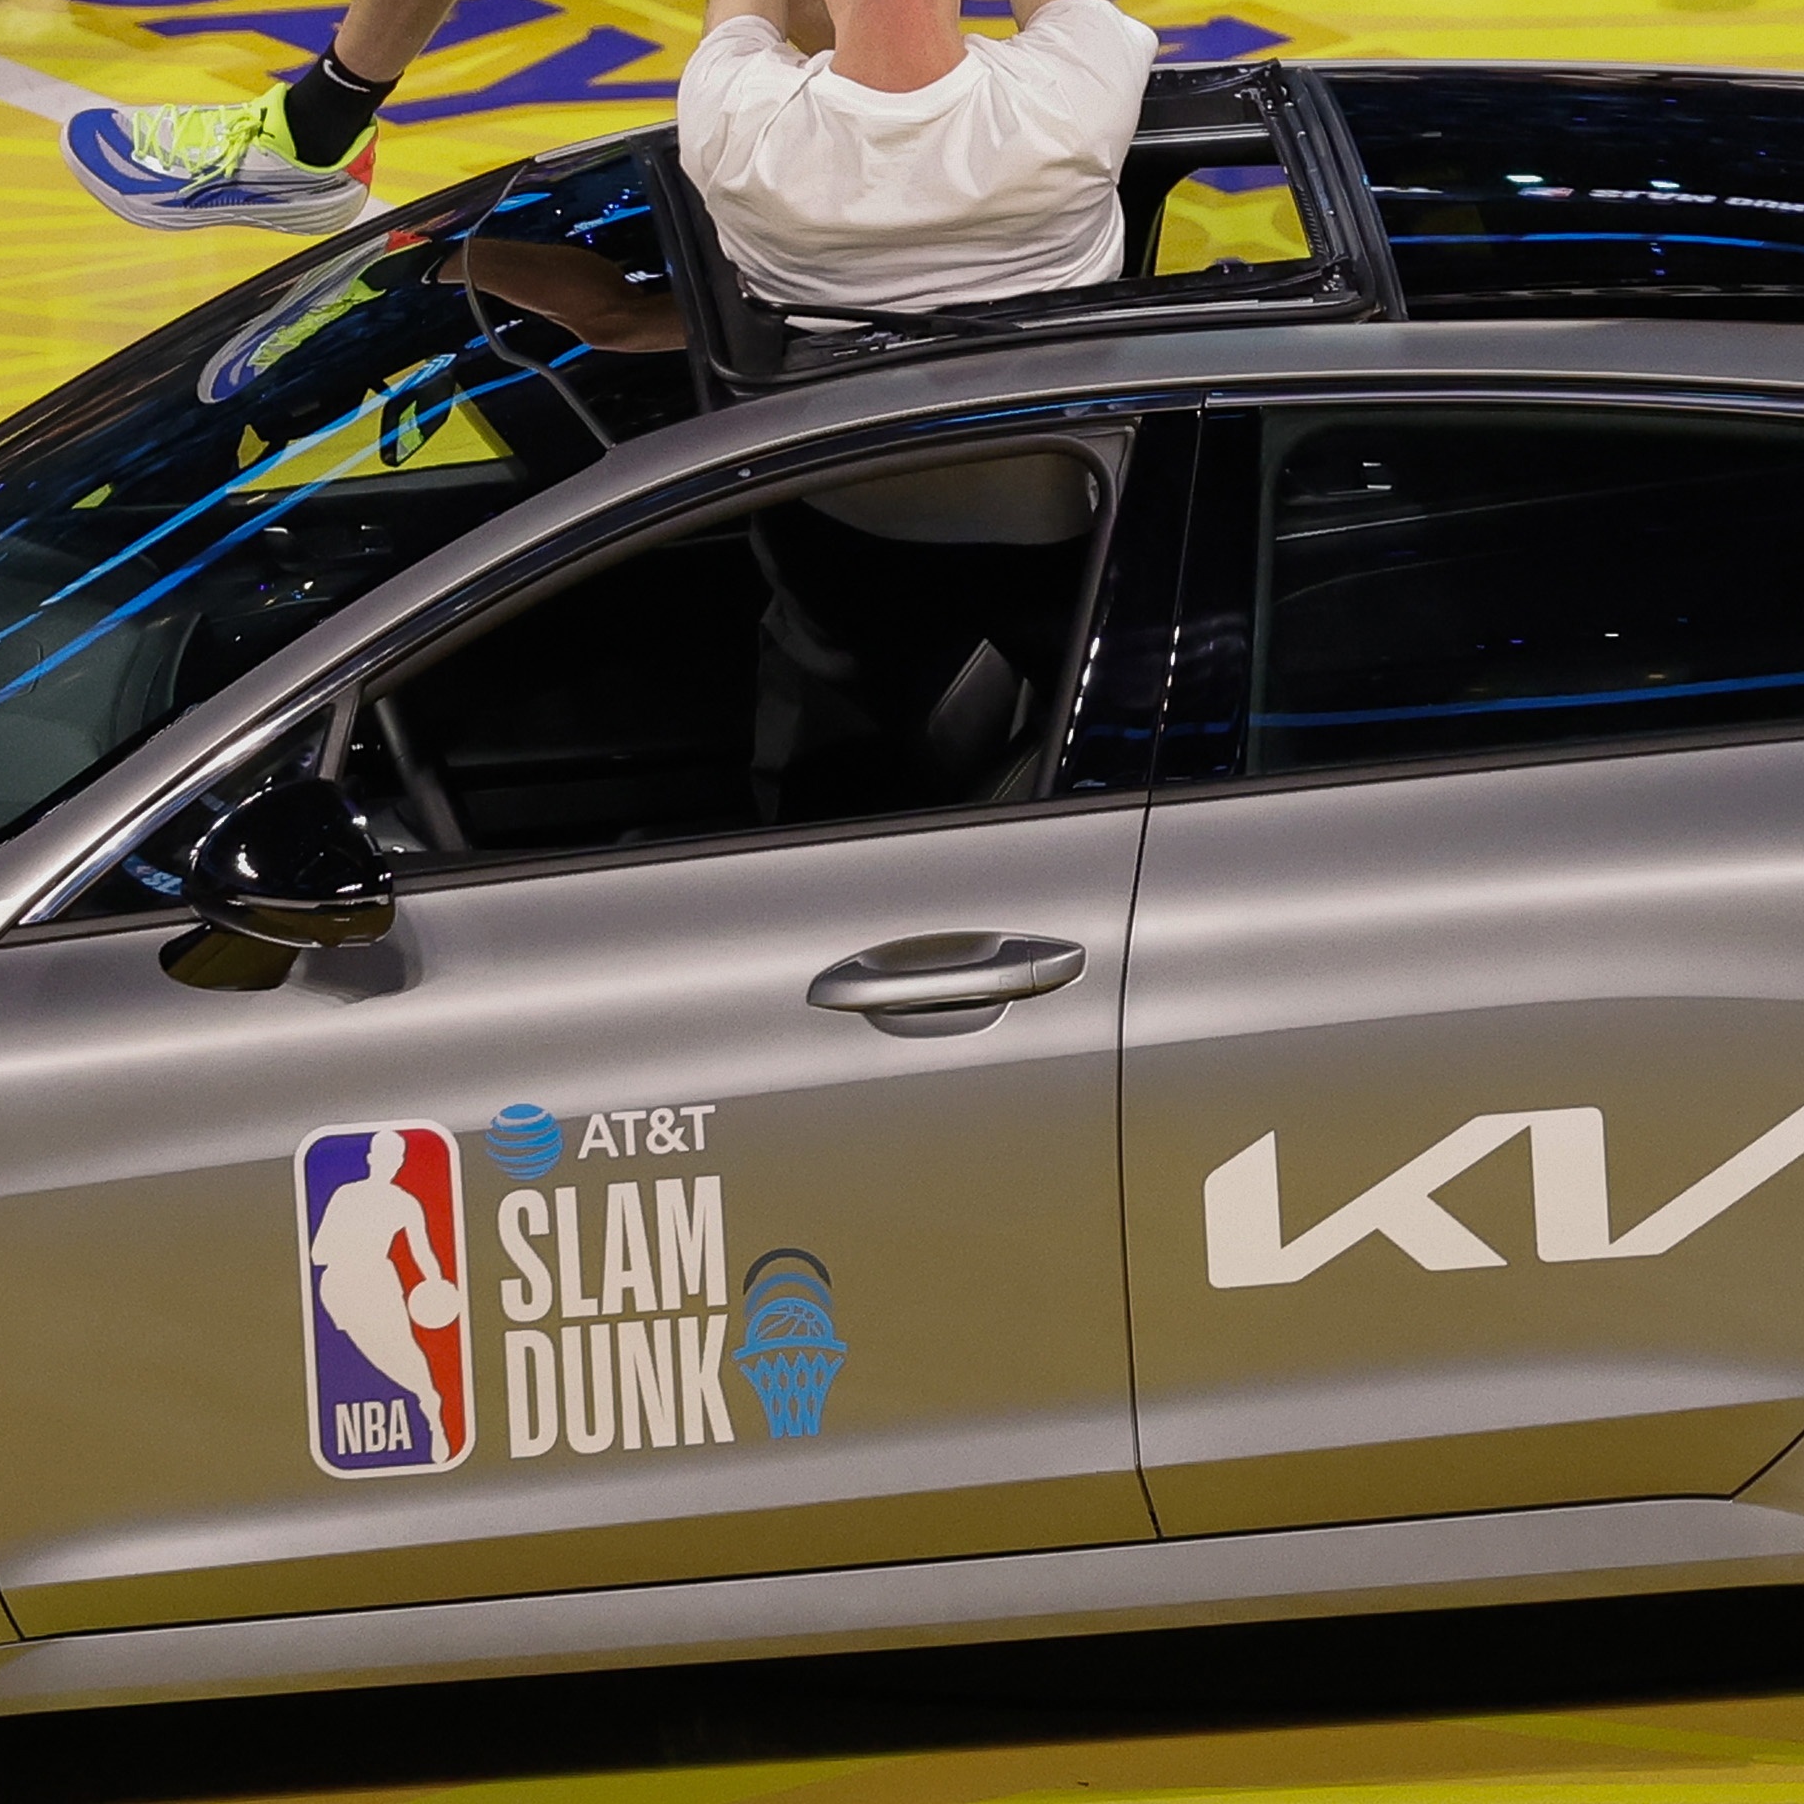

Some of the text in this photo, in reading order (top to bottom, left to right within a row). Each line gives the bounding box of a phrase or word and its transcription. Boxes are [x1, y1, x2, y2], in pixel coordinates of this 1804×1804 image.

[577, 1104, 716, 1161] AT&T
[497, 1174, 729, 1323] SLAM
[334, 1398, 413, 1457] NBA
[504, 1312, 736, 1460] DUNK
